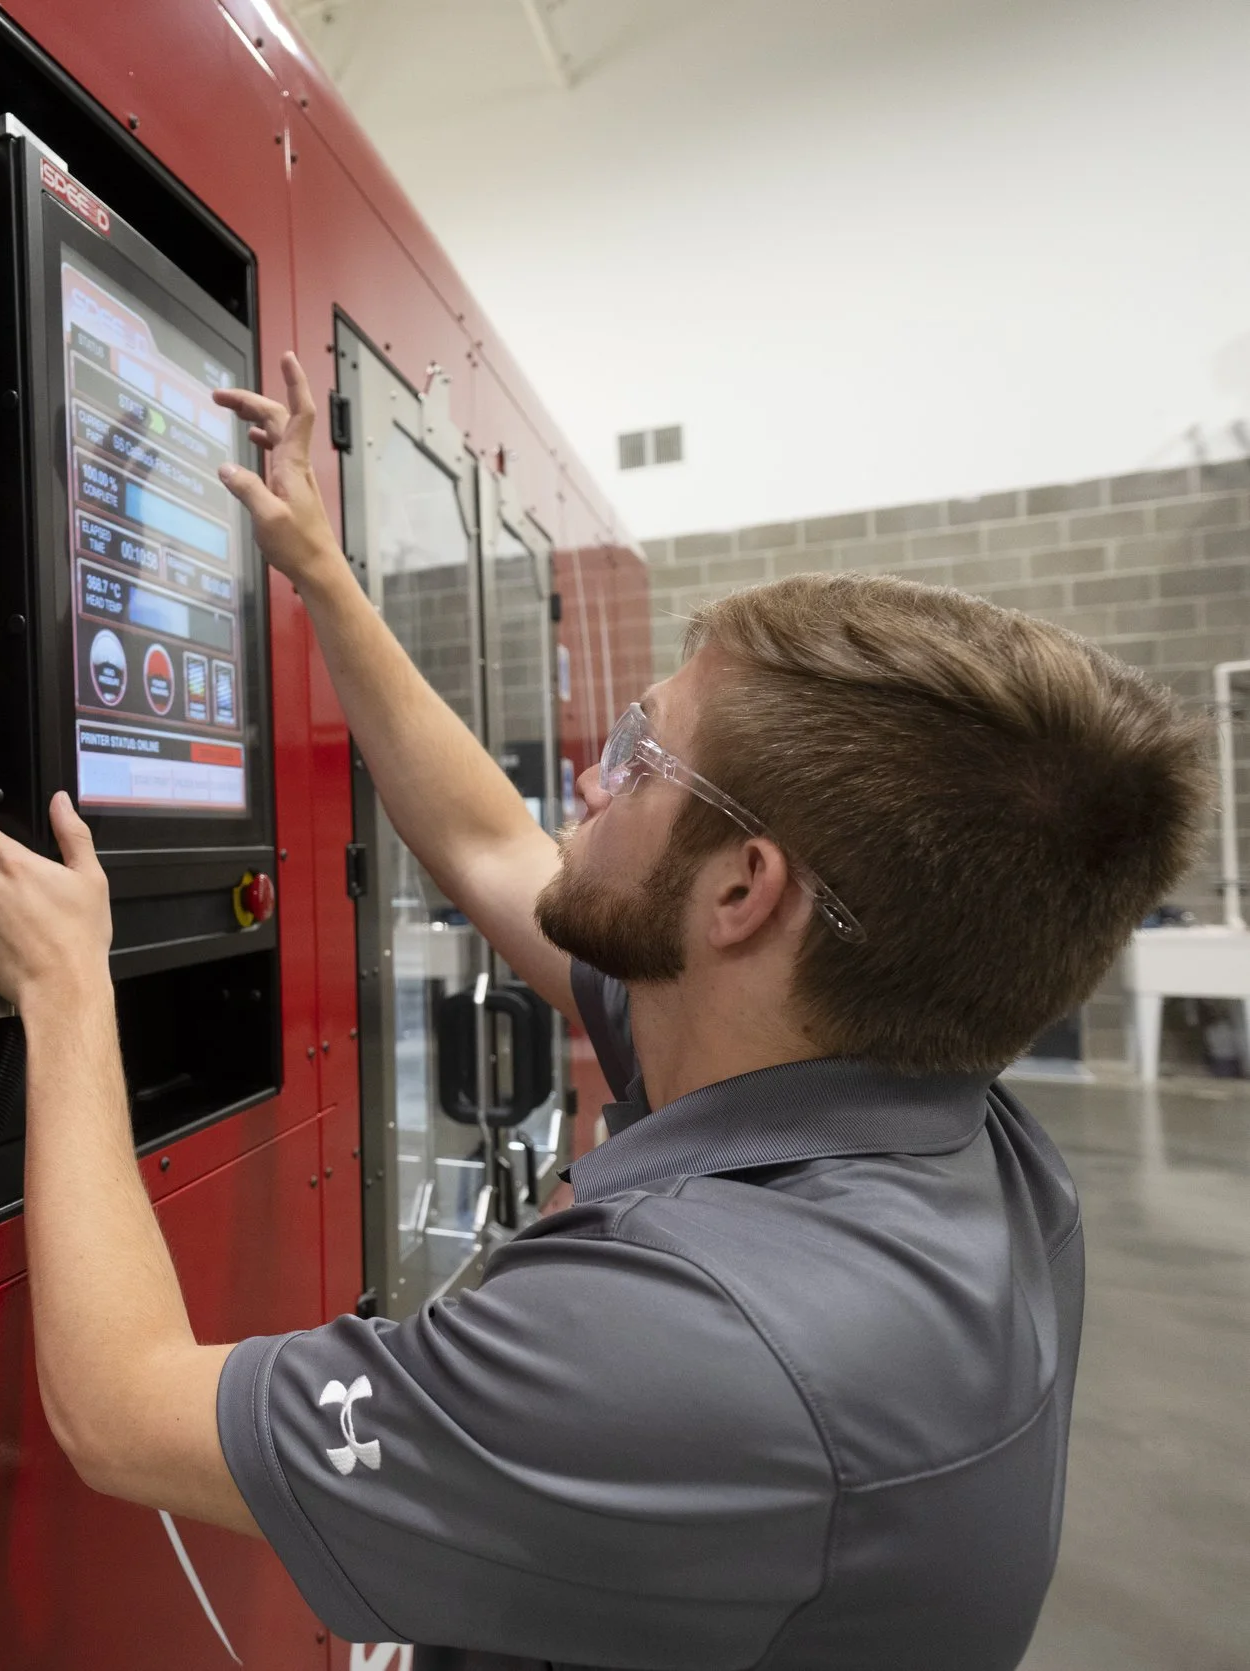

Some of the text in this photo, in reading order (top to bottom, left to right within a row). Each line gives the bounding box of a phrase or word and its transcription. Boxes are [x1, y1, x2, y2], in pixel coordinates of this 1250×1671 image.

[82, 482, 119, 508] COMPLETE
[81, 520, 112, 543] ELAPSED
[80, 732, 110, 747] PRINTER
